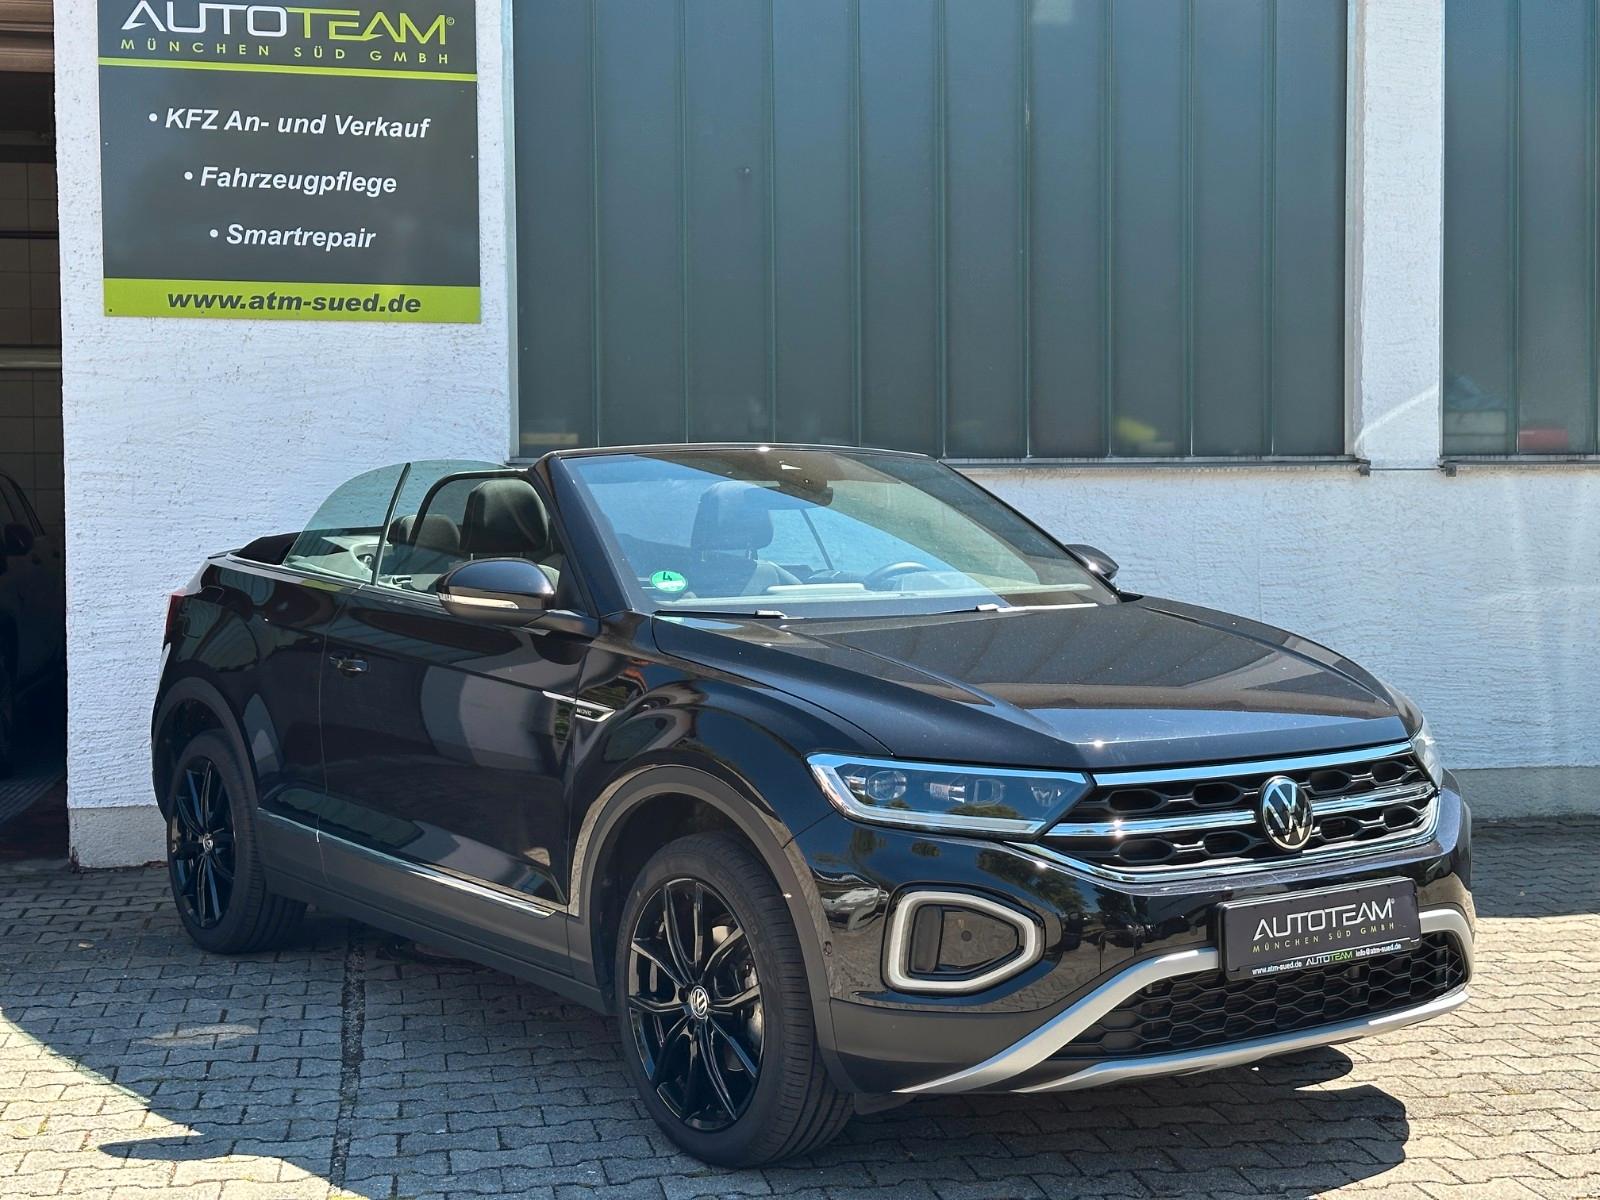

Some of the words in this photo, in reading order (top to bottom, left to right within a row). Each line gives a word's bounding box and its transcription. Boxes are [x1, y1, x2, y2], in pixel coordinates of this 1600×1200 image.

[120, 38, 269, 57] MÜNCHEN
[294, 46, 345, 60] SÜD
[370, 50, 448, 65] GMBH
[165, 107, 219, 131] KFZ
[224, 110, 269, 132] An-
[277, 114, 326, 135] und
[334, 114, 431, 139] Verkauf
[201, 166, 397, 198] Fahrzeugpflege
[226, 223, 376, 252] Smartrepair
[167, 291, 422, 313] www.atm-sued.de
[662, 571, 673, 581] 4
[1305, 951, 1354, 966] AUTOTEAM
